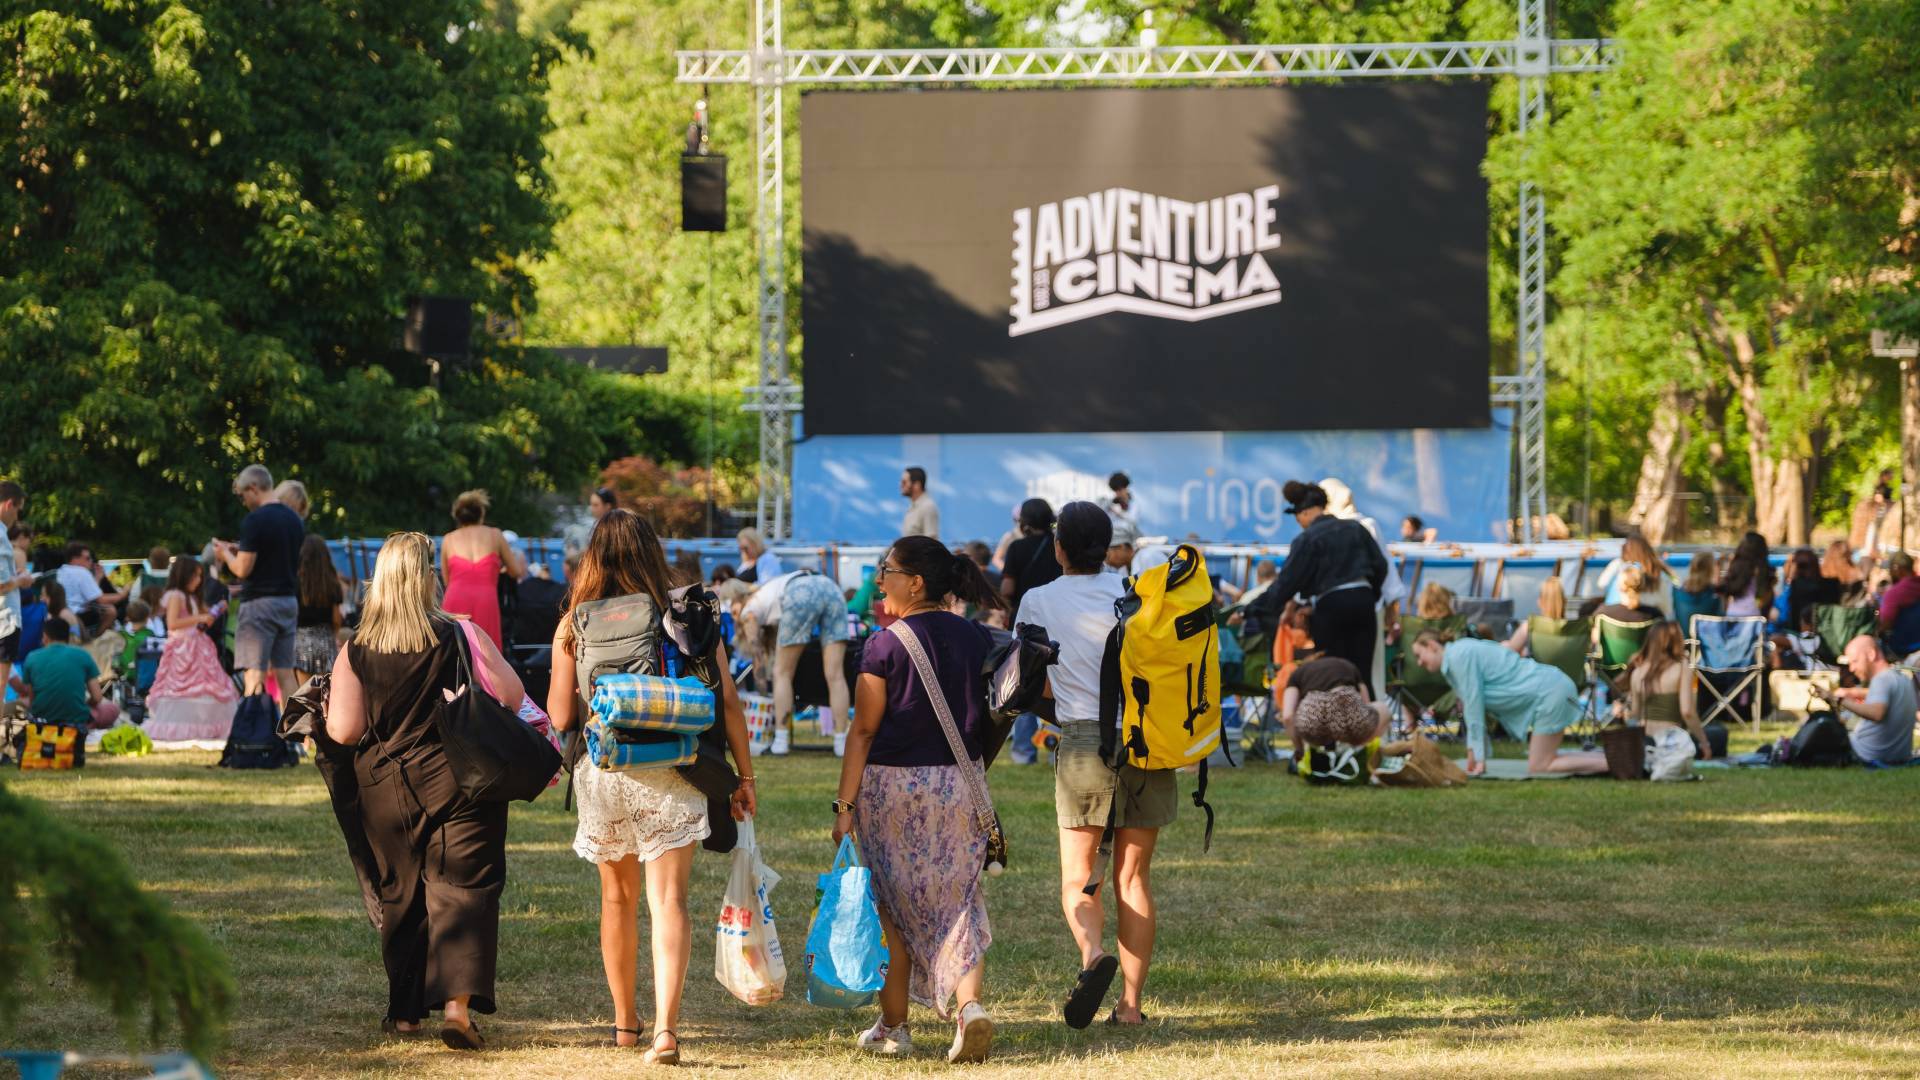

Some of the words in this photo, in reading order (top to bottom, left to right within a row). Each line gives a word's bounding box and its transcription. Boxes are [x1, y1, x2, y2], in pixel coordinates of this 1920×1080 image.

[1033, 184, 1281, 269] ADVENTURE
[1053, 252, 1281, 307] CINEMA
[1180, 467, 1283, 537] ring
